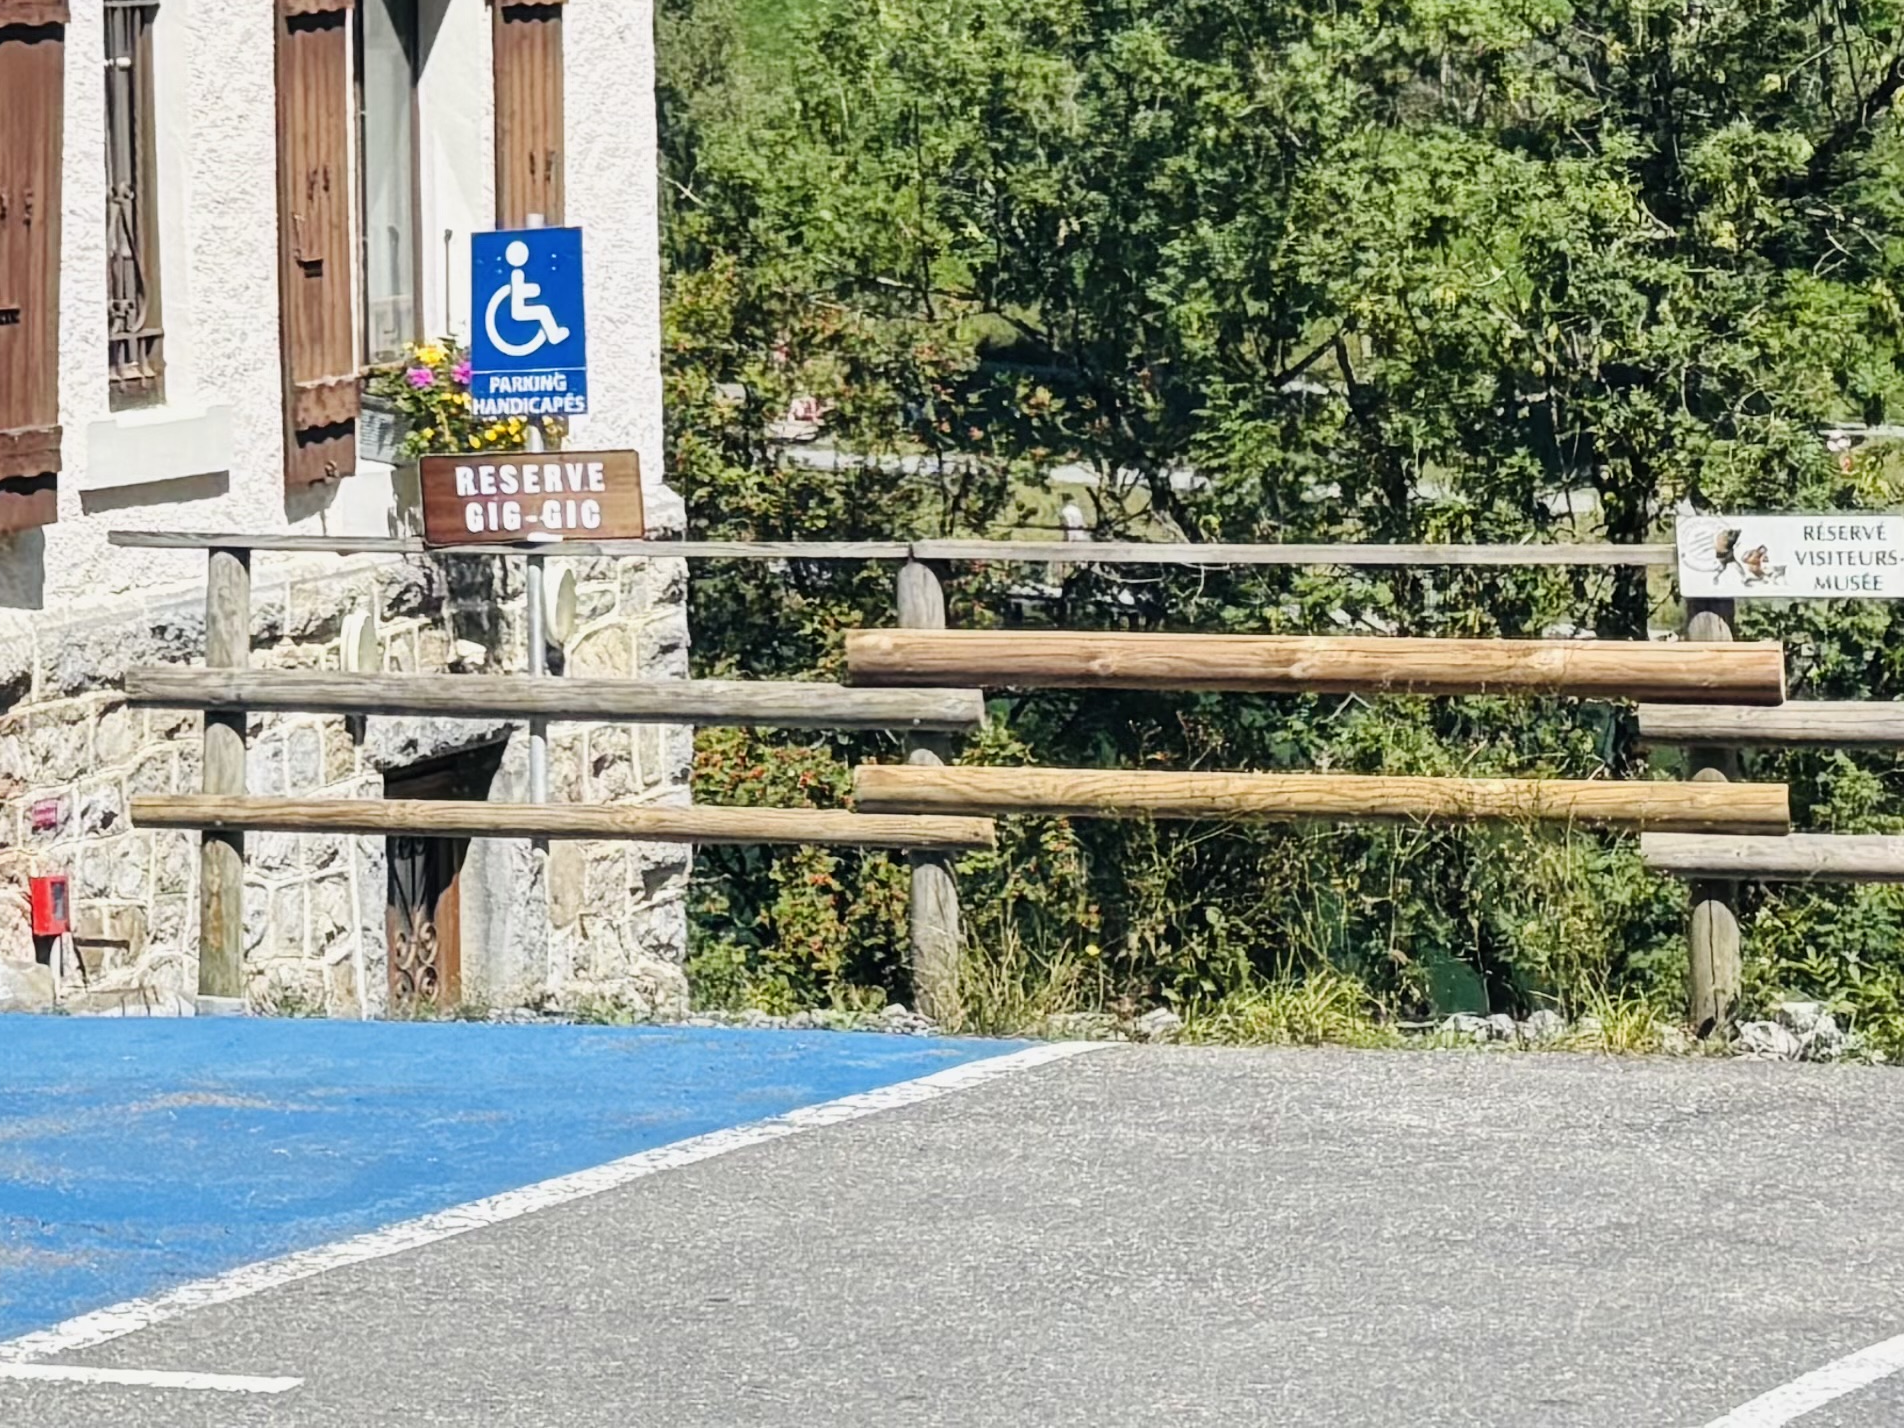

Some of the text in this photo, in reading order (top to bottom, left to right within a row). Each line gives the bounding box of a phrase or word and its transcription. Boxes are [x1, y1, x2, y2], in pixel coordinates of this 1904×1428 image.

[489, 372, 568, 394] PARKING
[472, 392, 586, 415] HANDICAPÉS
[455, 462, 606, 496] RESERVE
[1803, 521, 1888, 542] RÉSERVÉ
[1813, 572, 1884, 591] MUSÉE
